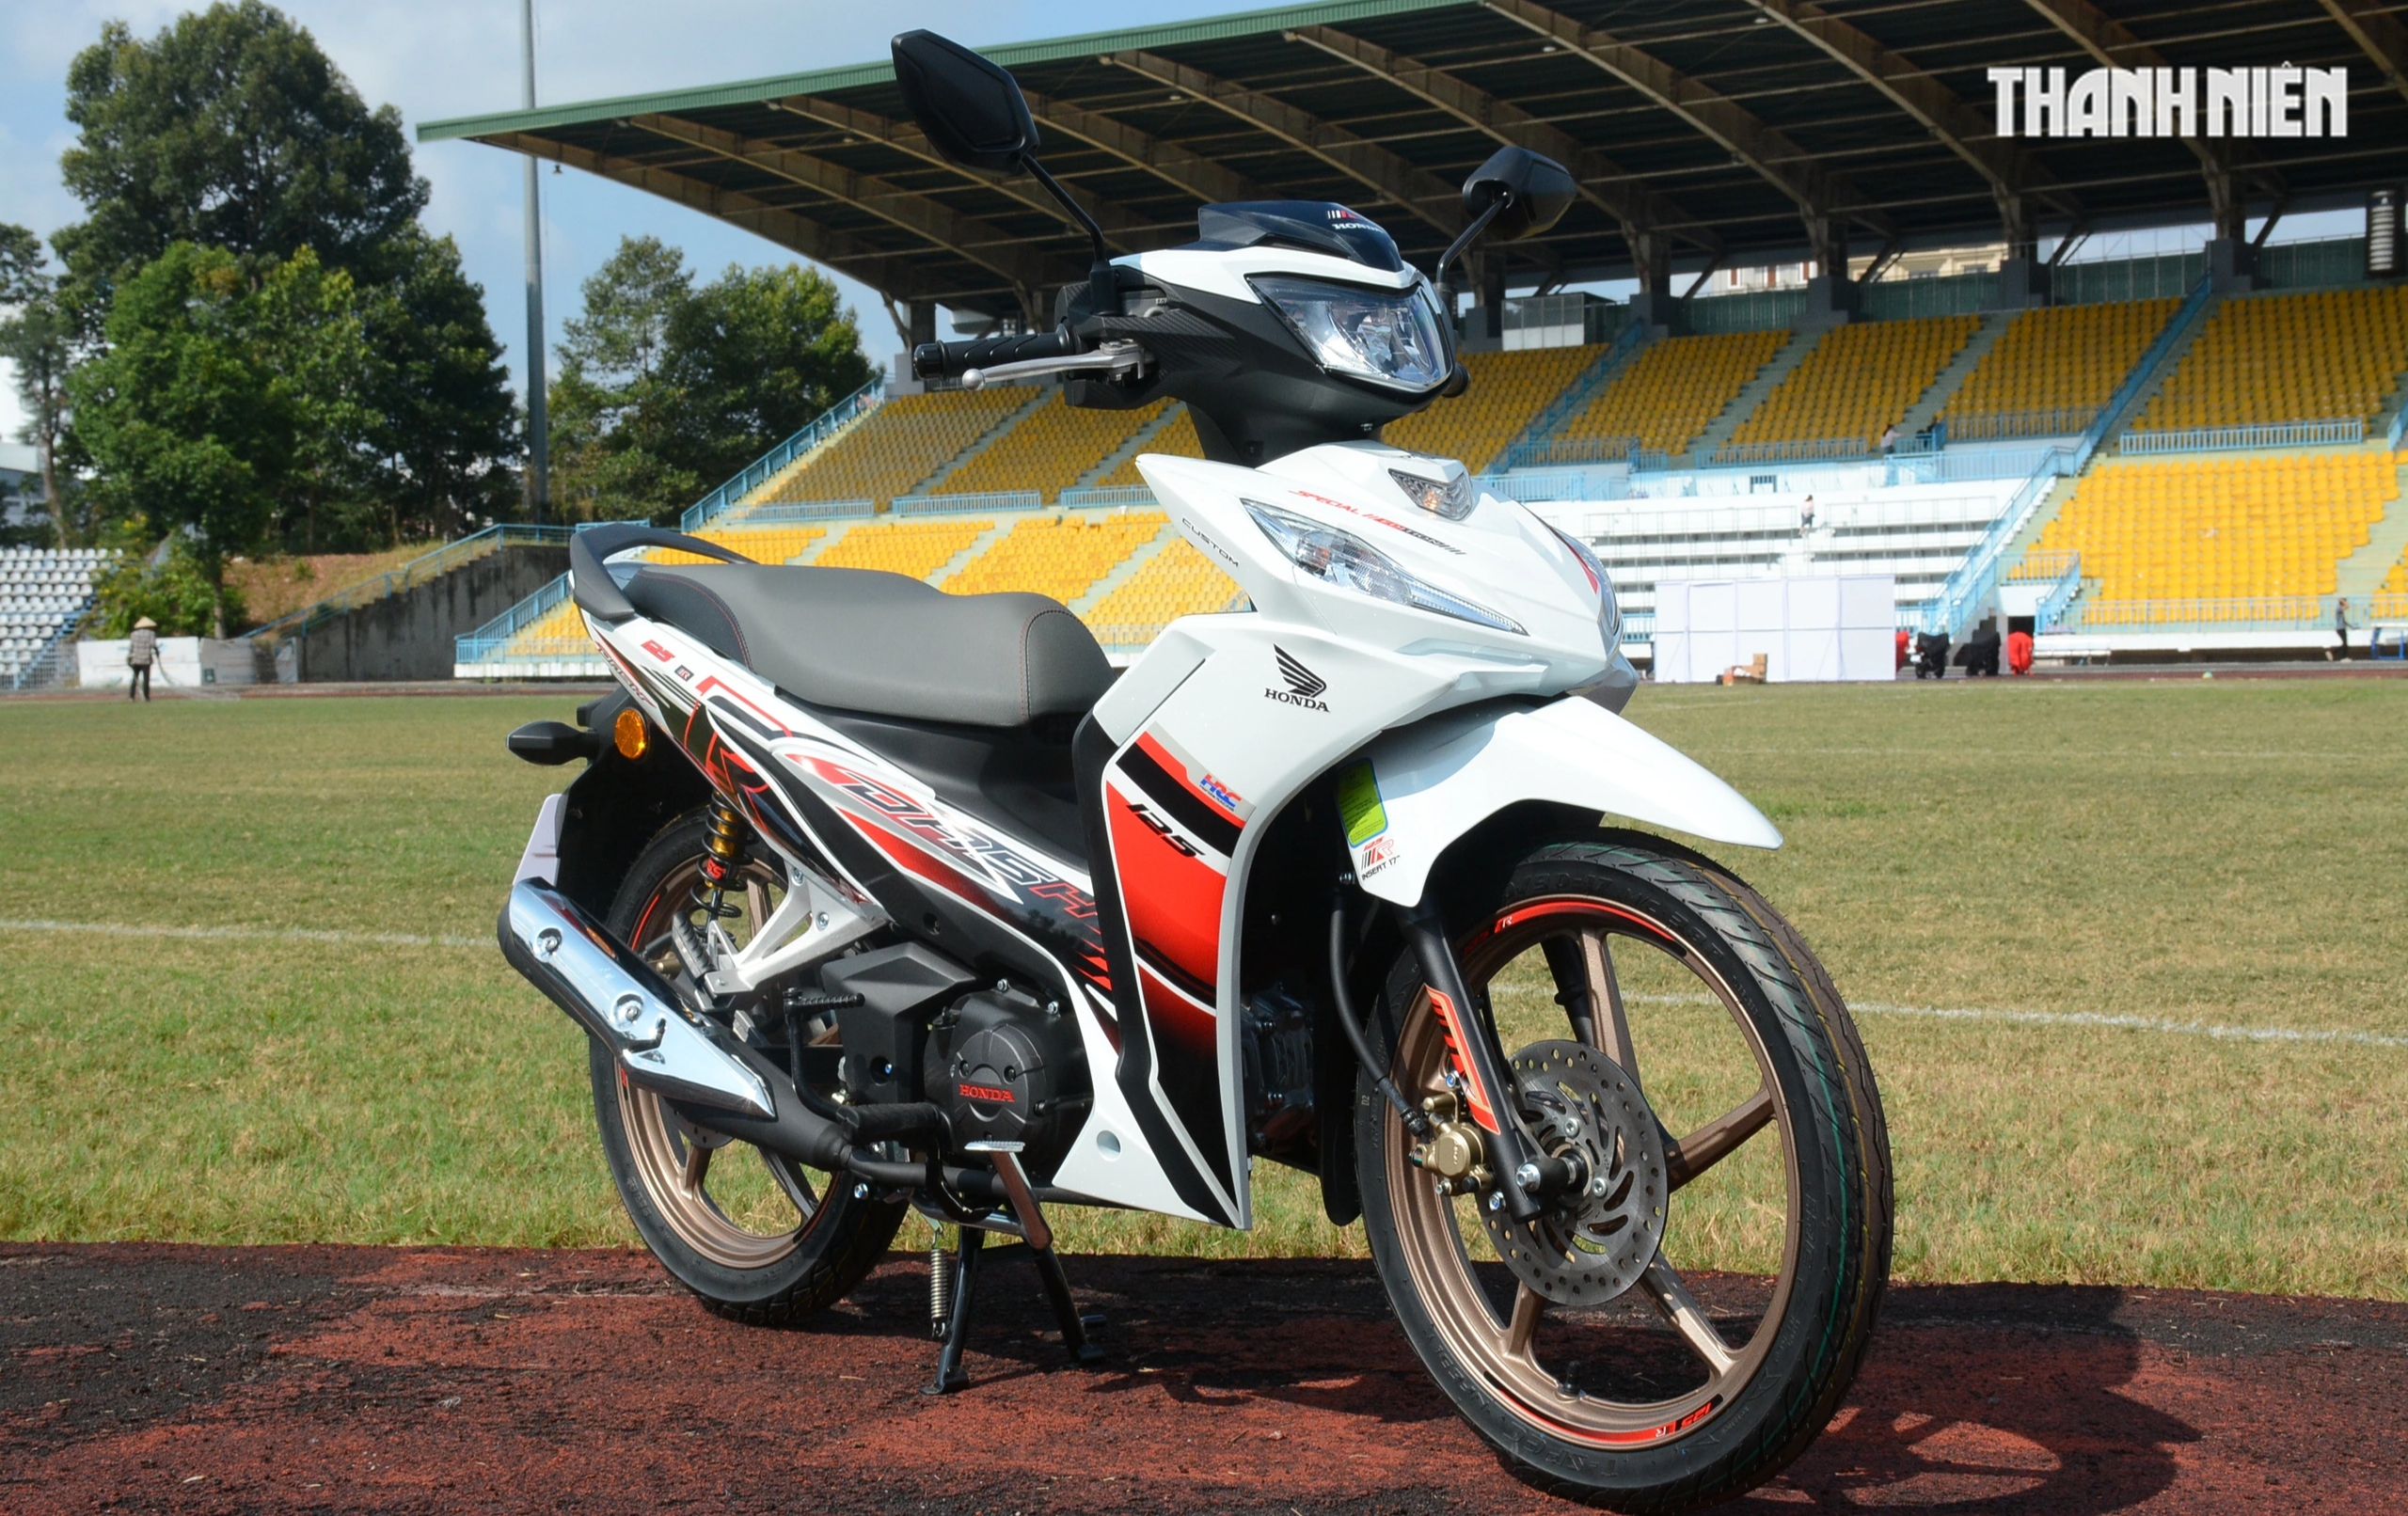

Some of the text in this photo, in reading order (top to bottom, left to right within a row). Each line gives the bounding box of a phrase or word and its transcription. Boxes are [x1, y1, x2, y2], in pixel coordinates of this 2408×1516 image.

[1288, 490, 1359, 514] SPECIAL
[1181, 517, 1240, 568] CUSTOM
[1264, 687, 1330, 713] HONDA
[1200, 773, 1242, 808] HRC
[1126, 803, 1206, 858] 125
[1361, 862, 1387, 881] INSERT
[959, 1083, 1016, 1102] HONDA
